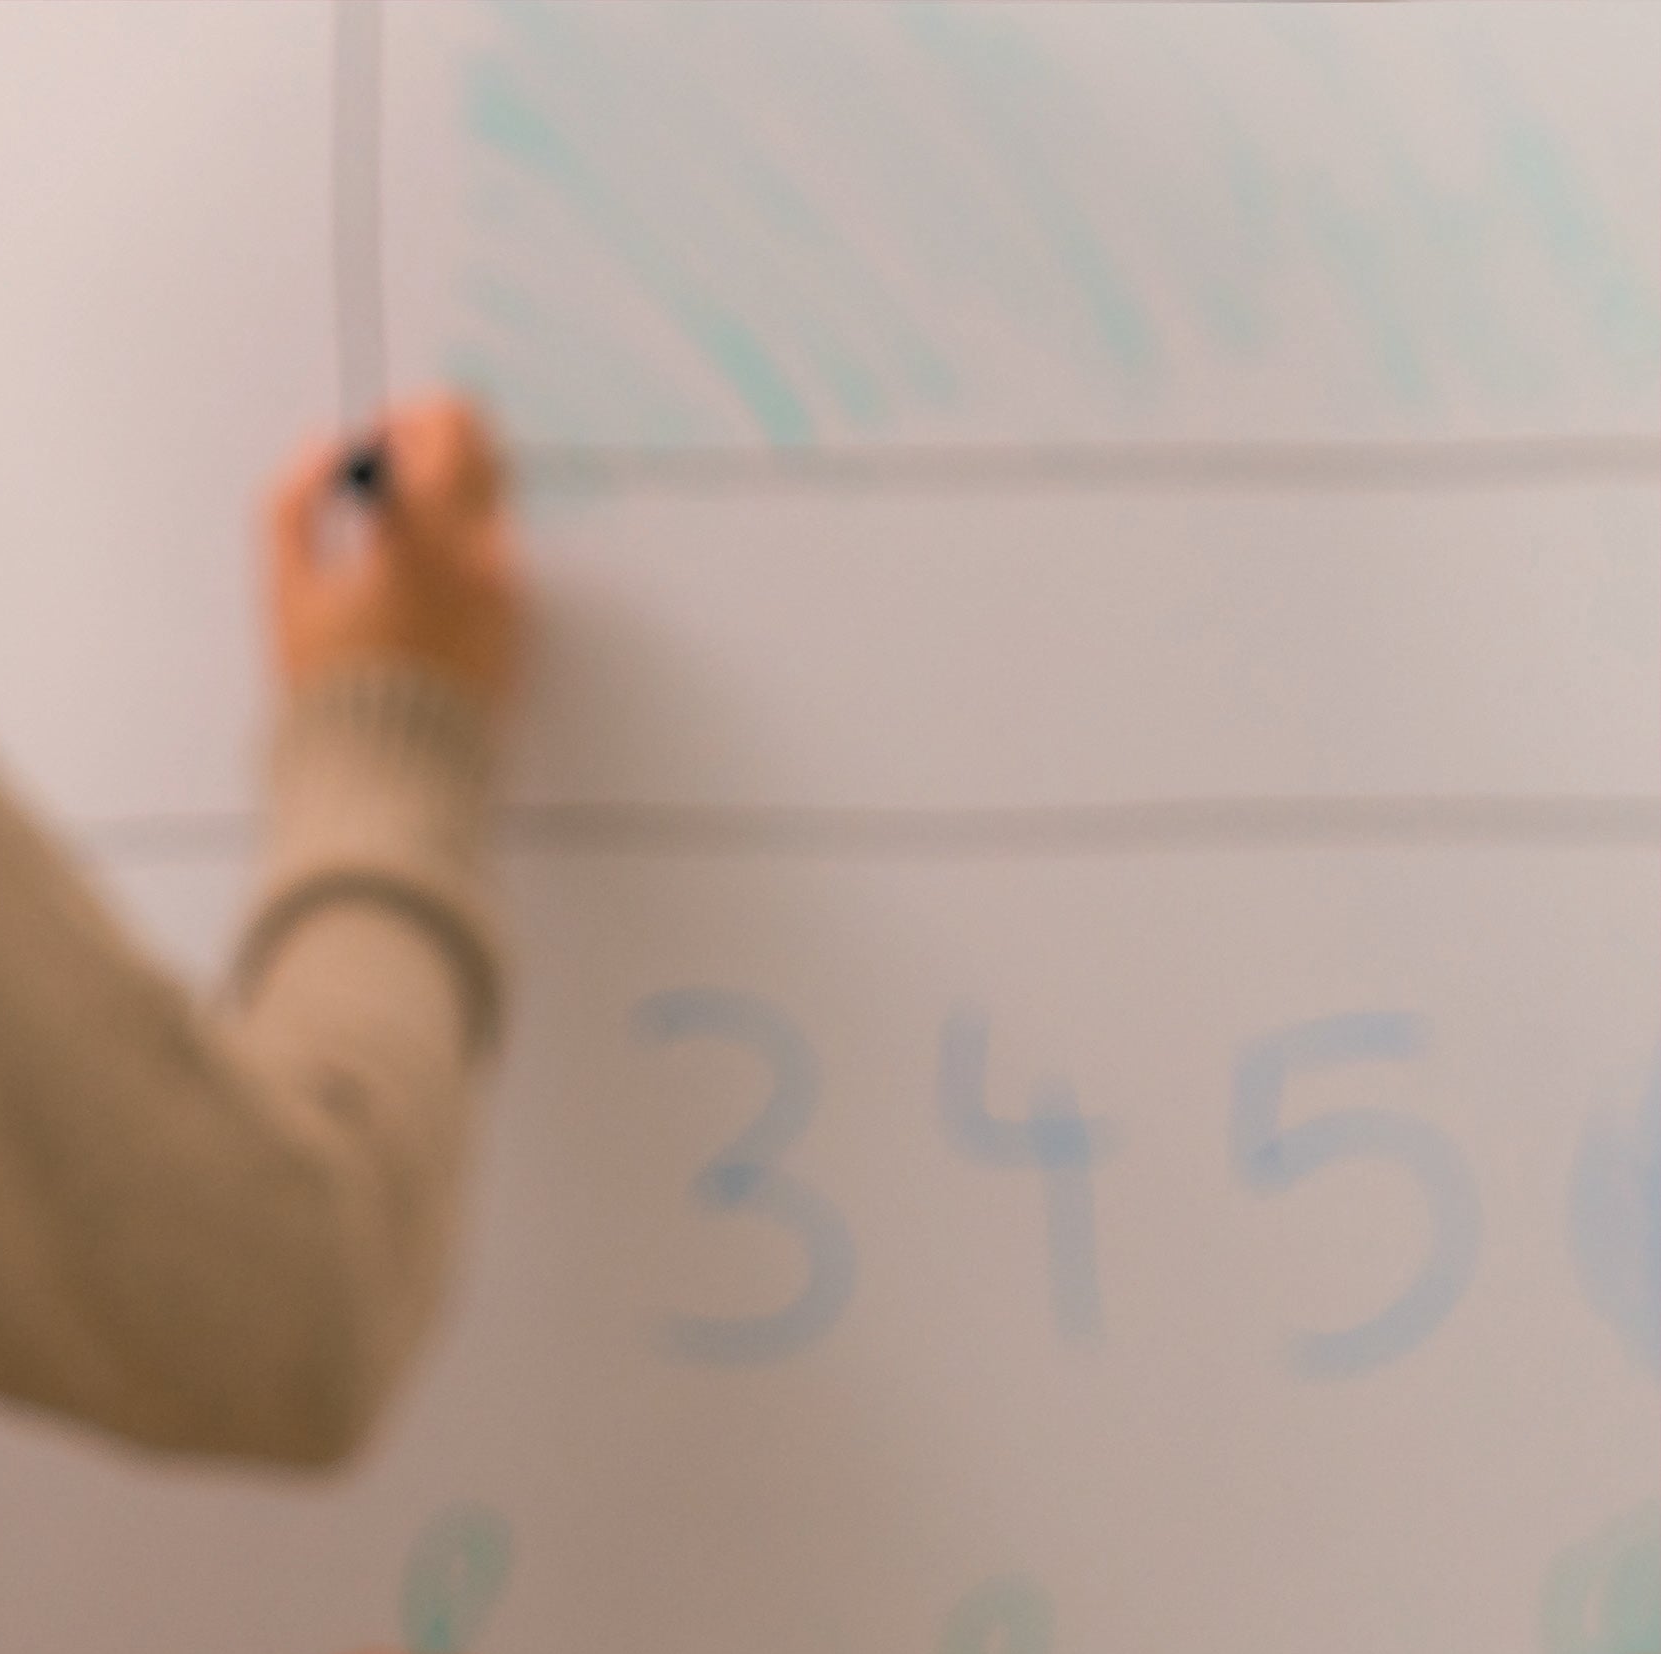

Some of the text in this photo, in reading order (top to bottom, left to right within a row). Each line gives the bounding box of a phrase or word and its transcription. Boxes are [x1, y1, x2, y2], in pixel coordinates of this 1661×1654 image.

[627, 986, 856, 1371] 3
[941, 1010, 1111, 1351] 4
[1231, 1010, 1484, 1384] 5
